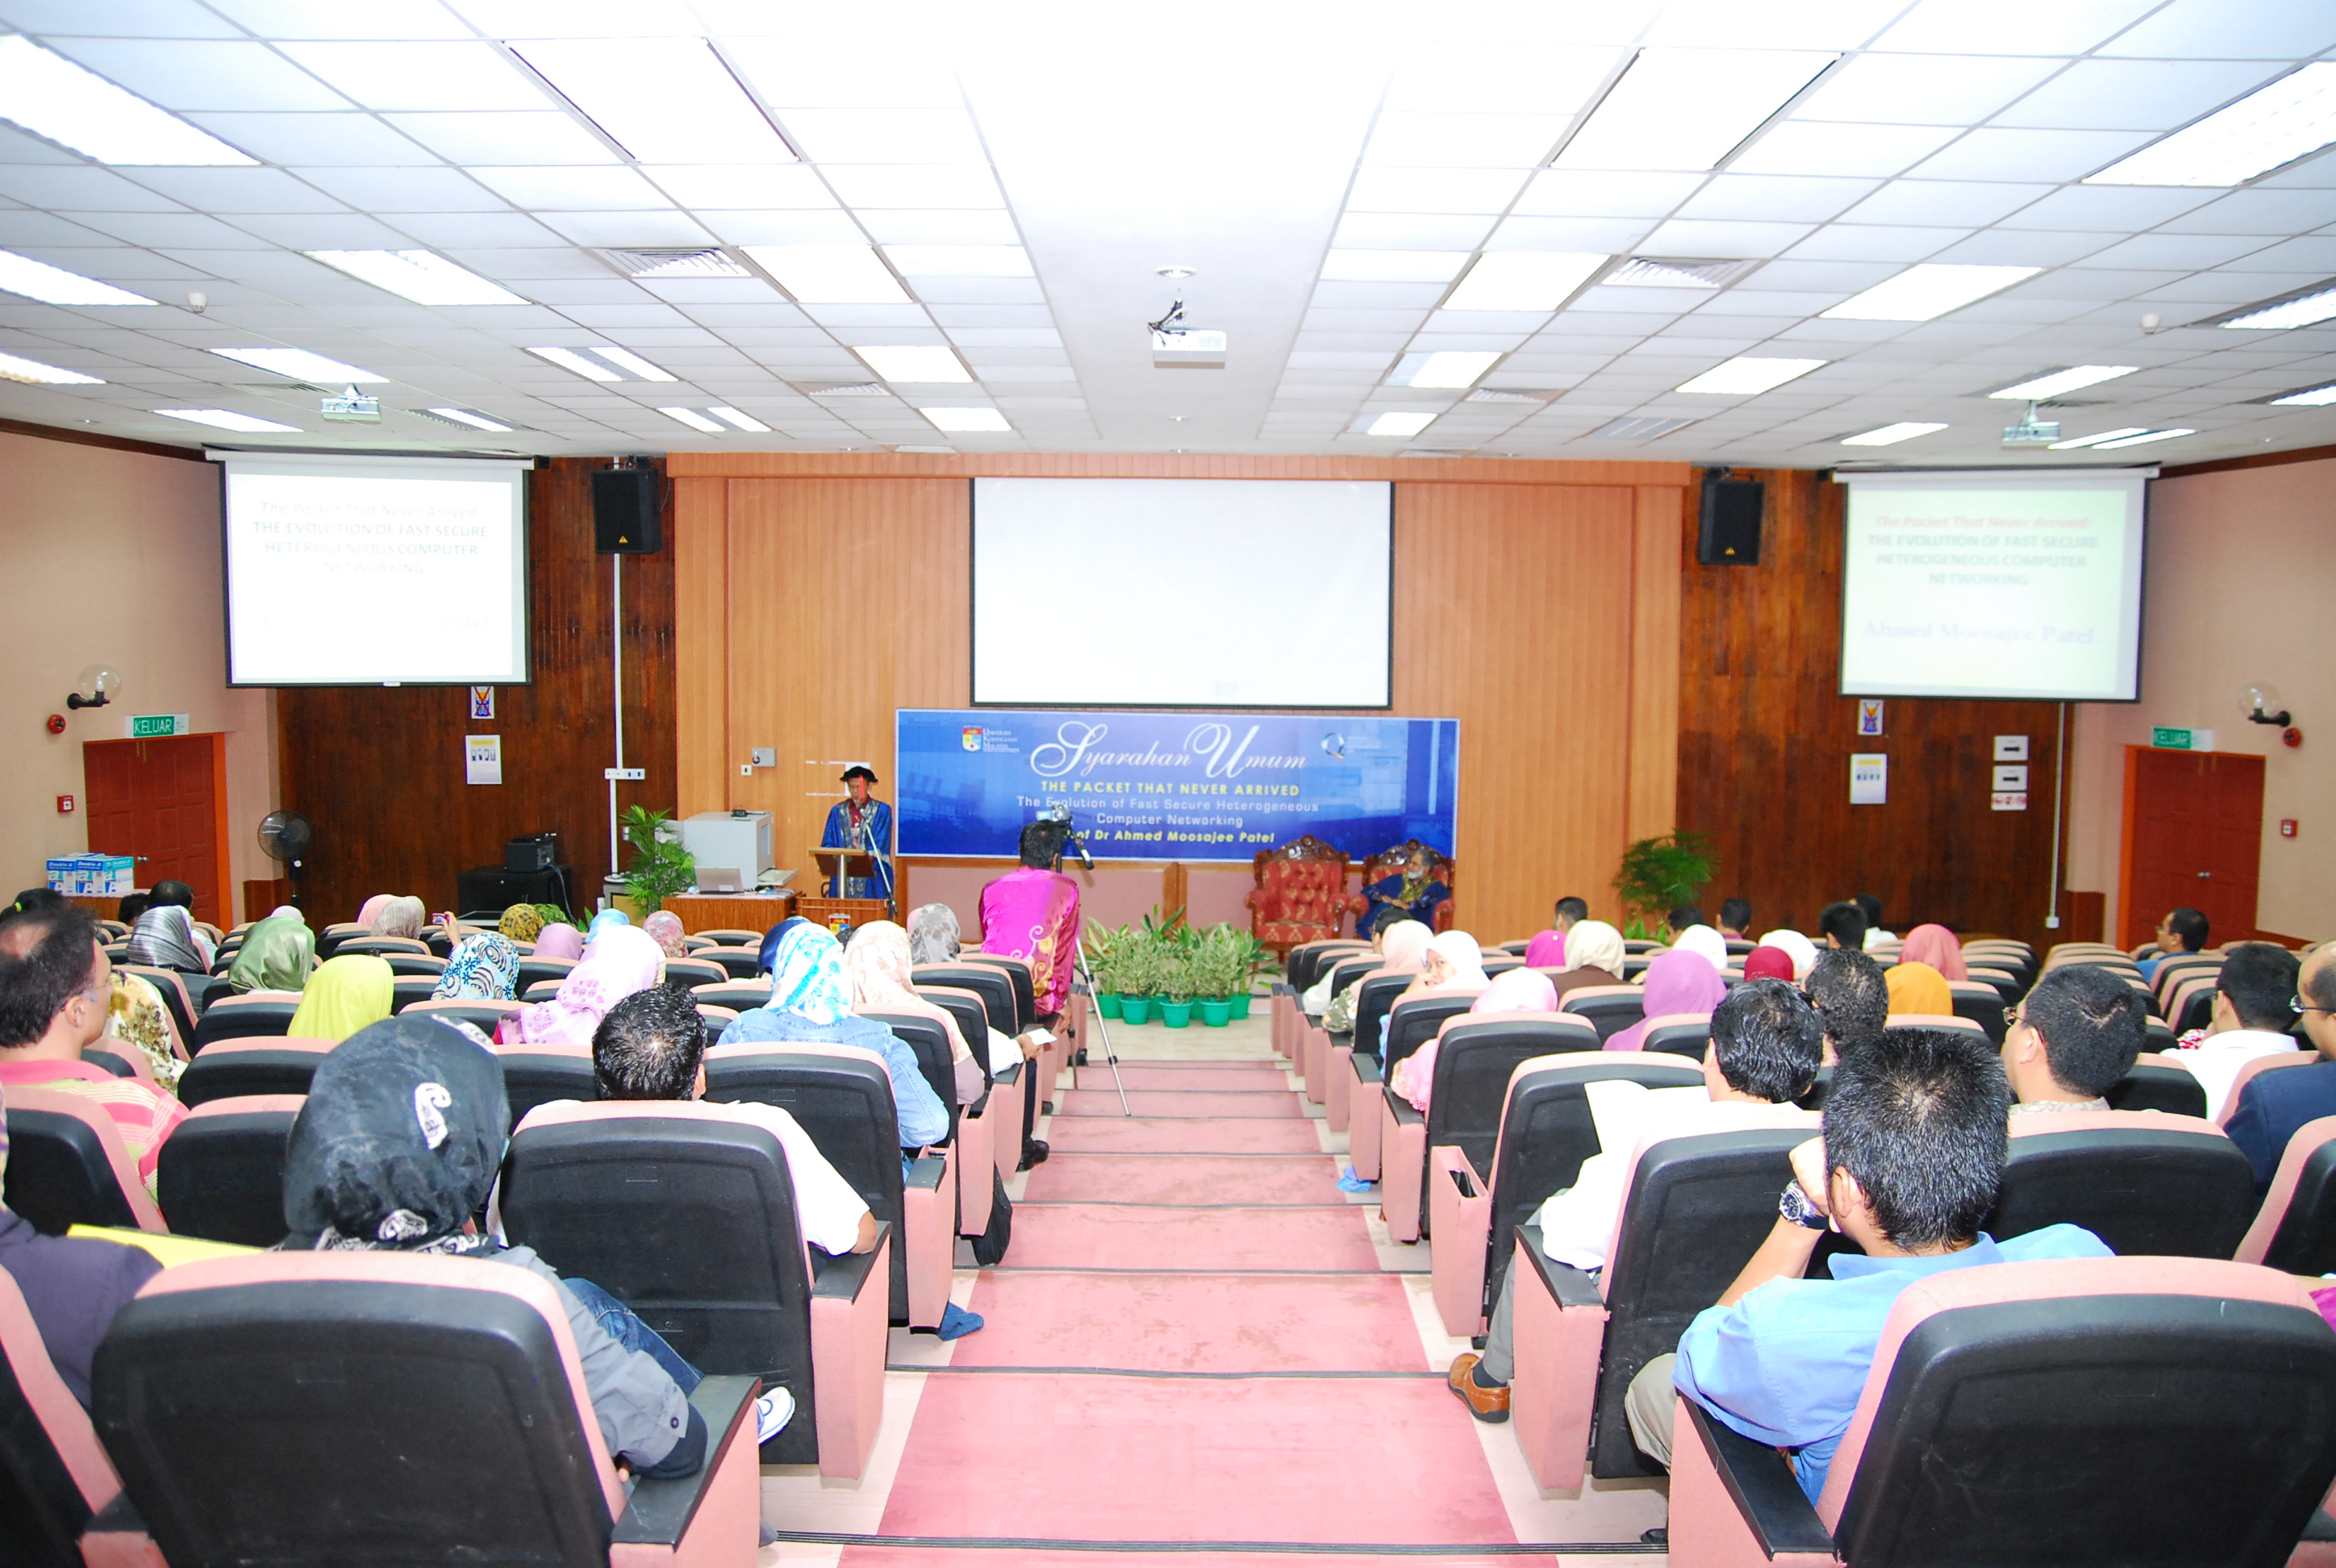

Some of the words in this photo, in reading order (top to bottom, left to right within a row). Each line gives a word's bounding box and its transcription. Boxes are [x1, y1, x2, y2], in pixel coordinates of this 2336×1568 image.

[261, 502, 286, 514] The
[252, 521, 281, 533] THE
[286, 522, 372, 535] EVOLUTION
[376, 523, 393, 535] OF
[399, 524, 429, 536] FAST
[435, 525, 487, 537] SECURE
[1876, 515, 1898, 527] The
[1904, 516, 1949, 527] Packet
[1954, 517, 1983, 527] That
[1988, 517, 2029, 528] Never
[265, 541, 394, 555] HETEROGENEOUS
[398, 544, 478, 556] COMPUTER
[1867, 534, 1892, 545] THE
[1896, 534, 1979, 546] EVOLUTION
[1982, 536, 2000, 546] OF
[2005, 536, 2038, 548] FAST
[2042, 536, 2097, 548] SECURE
[1876, 553, 2000, 566] HETEROGENEOUS
[2003, 555, 2088, 567] COMPUTER
[324, 562, 423, 574] NETWORKING
[1929, 573, 2028, 585] NETWORKING
[1863, 621, 1933, 637] Ahmed
[2042, 626, 2095, 644] Patel
[134, 719, 172, 733] KELUAR
[1030, 721, 1192, 777] Syarahan
[1183, 723, 1309, 778] Umum
[1041, 781, 1066, 792] THE
[1074, 782, 1131, 793] PACKET
[1137, 782, 1173, 794] THAT
[1180, 784, 1228, 795] NEVER
[1235, 785, 1299, 796] ARRIVED
[1017, 795, 1041, 807] The
[1046, 796, 1106, 808] Eolution
[1112, 798, 1125, 809] of
[1130, 798, 1159, 809] Fast
[1164, 799, 1211, 810] Secure
[1216, 800, 1319, 814] Heterogeneous
[1097, 813, 1162, 826] Computer
[1167, 815, 1243, 828] Networking
[1095, 829, 1109, 840] Dr
[1114, 830, 1163, 841] Ahmed
[1167, 832, 1234, 844] Moosajee
[1239, 832, 1275, 843] Patel
